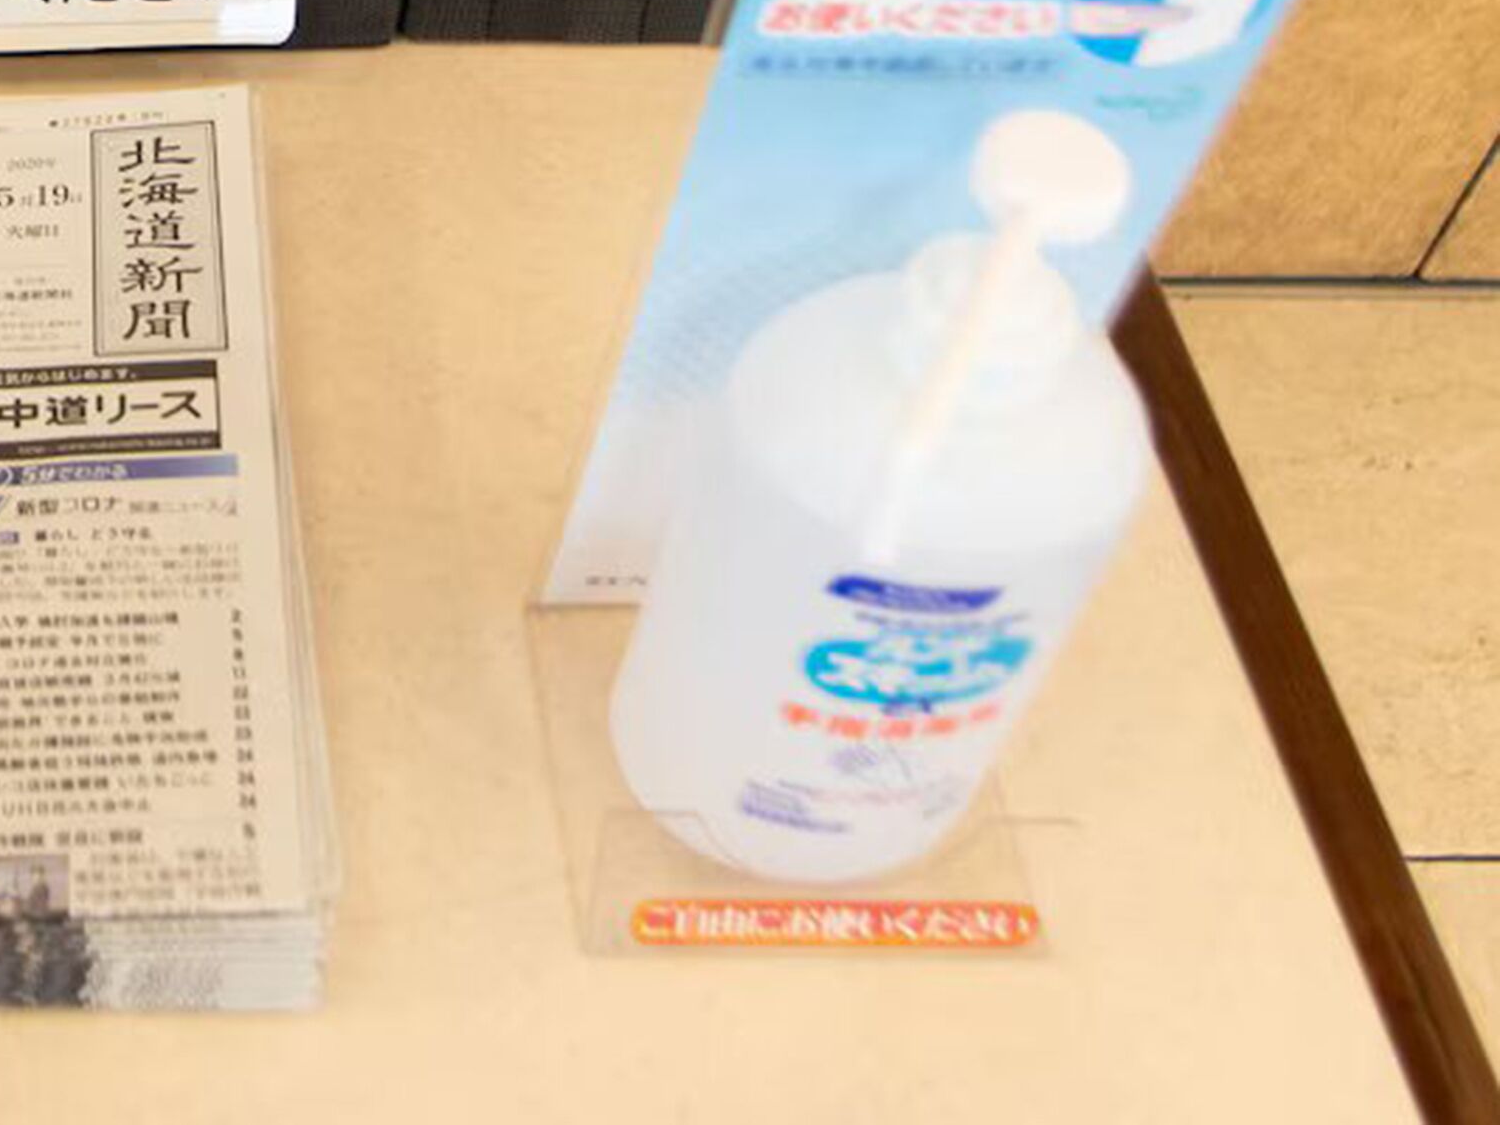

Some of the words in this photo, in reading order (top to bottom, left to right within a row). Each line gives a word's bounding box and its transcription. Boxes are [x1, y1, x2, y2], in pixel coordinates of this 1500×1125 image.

[117, 136, 204, 340] 北海道新聞
[16, 495, 120, 516] 新型コロナ
